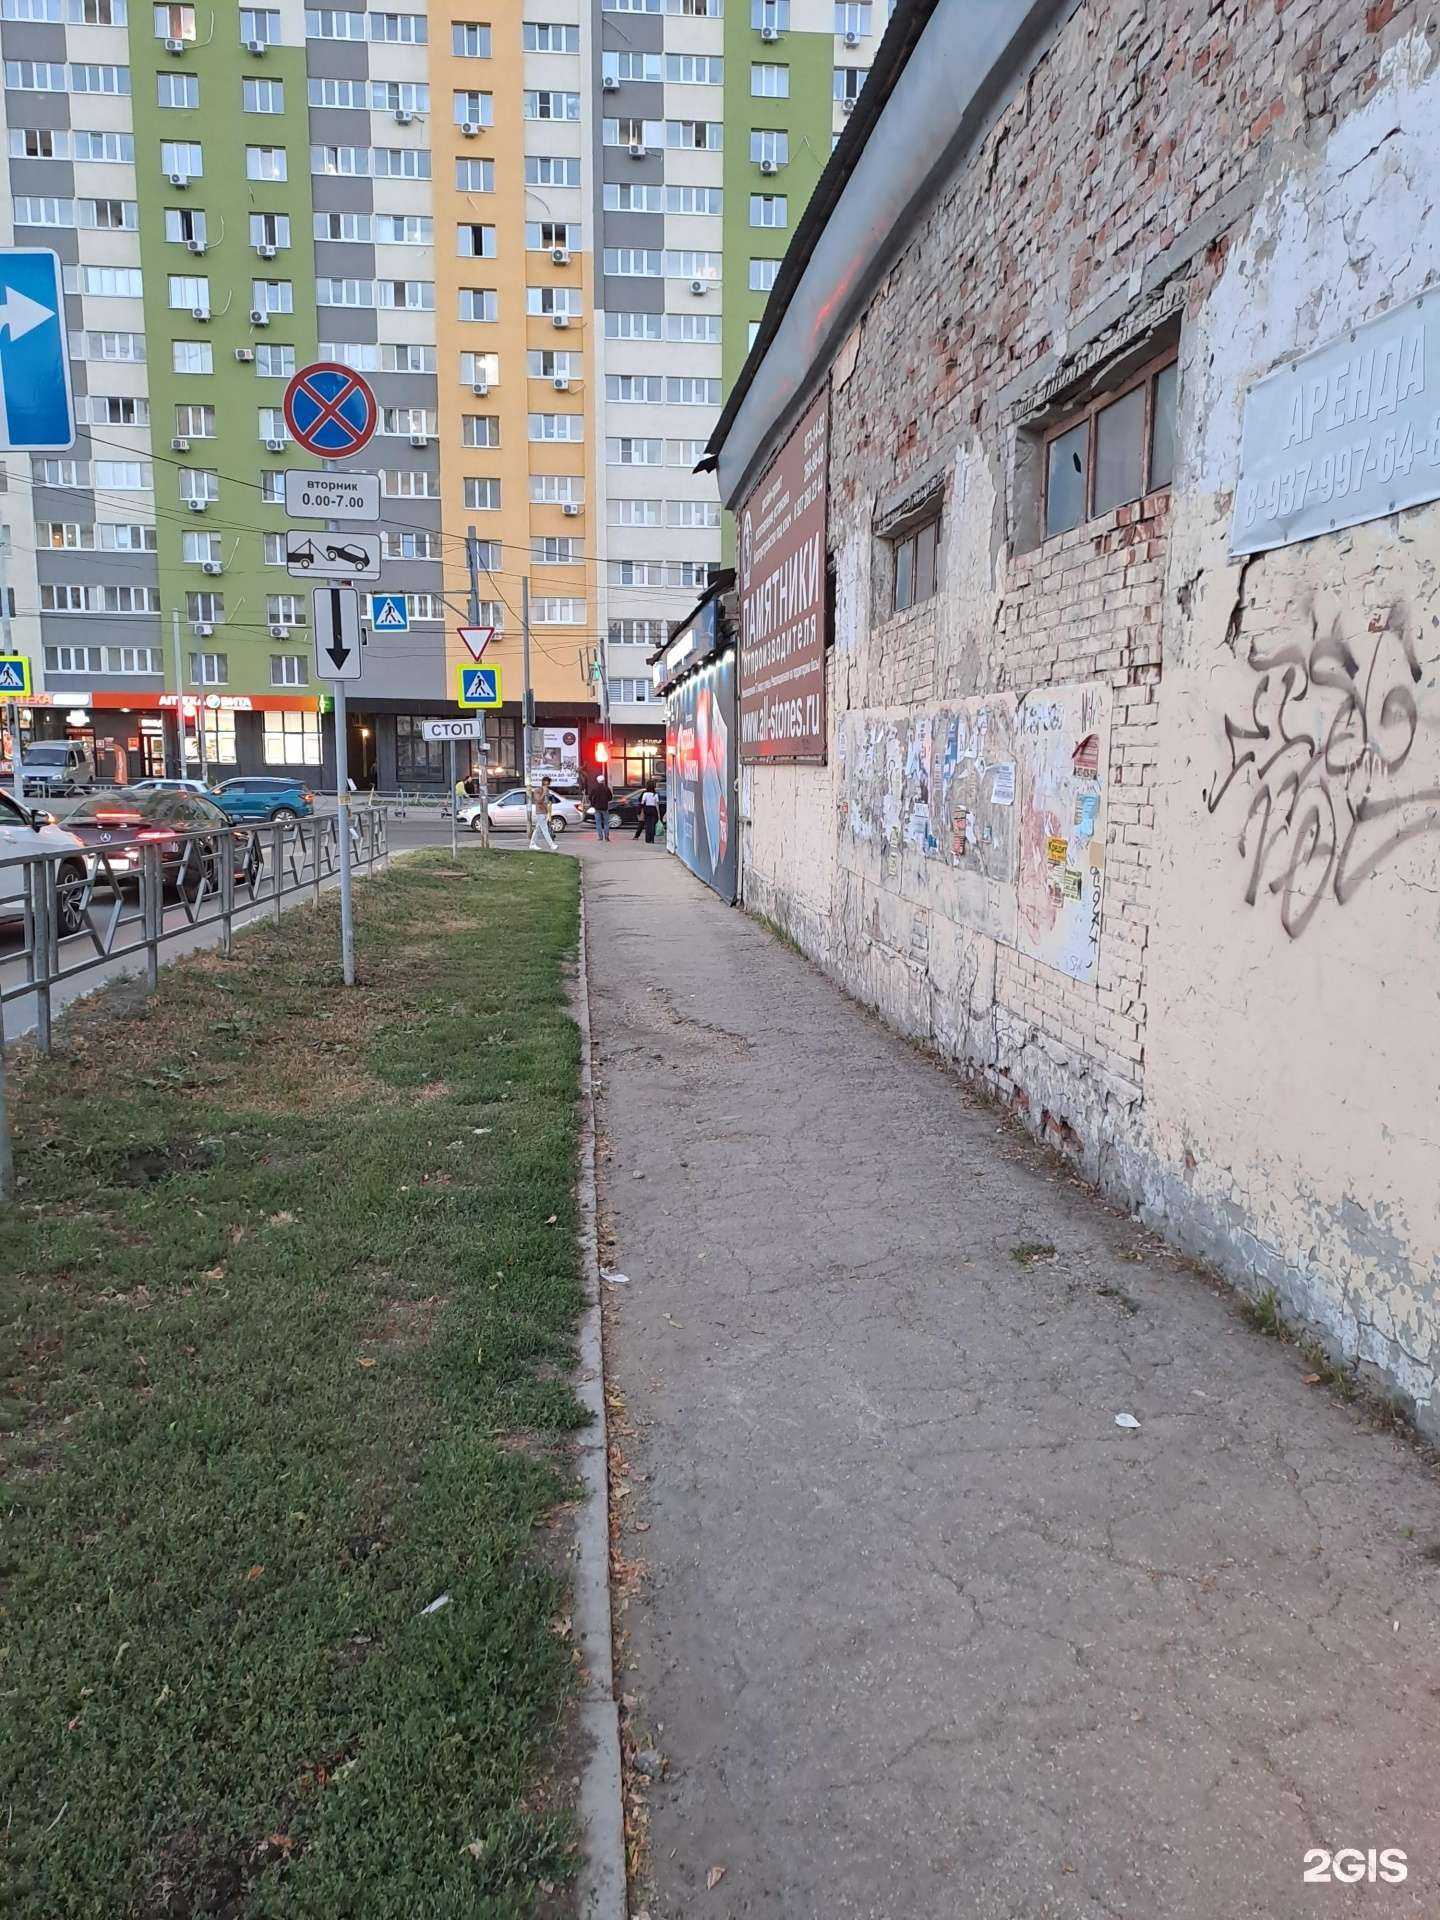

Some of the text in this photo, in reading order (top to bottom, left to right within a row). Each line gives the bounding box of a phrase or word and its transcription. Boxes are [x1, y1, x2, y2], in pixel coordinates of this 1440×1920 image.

[1280, 321, 1425, 452] АРЕНДА
[302, 492, 364, 508] 0.00-7.00
[307, 480, 359, 492] вторник
[743, 532, 820, 651] ПАМЯТНИКИ
[751, 613, 816, 680] производителя
[431, 723, 473, 736] СТОП
[741, 693, 820, 743] www.all-stones.ru
